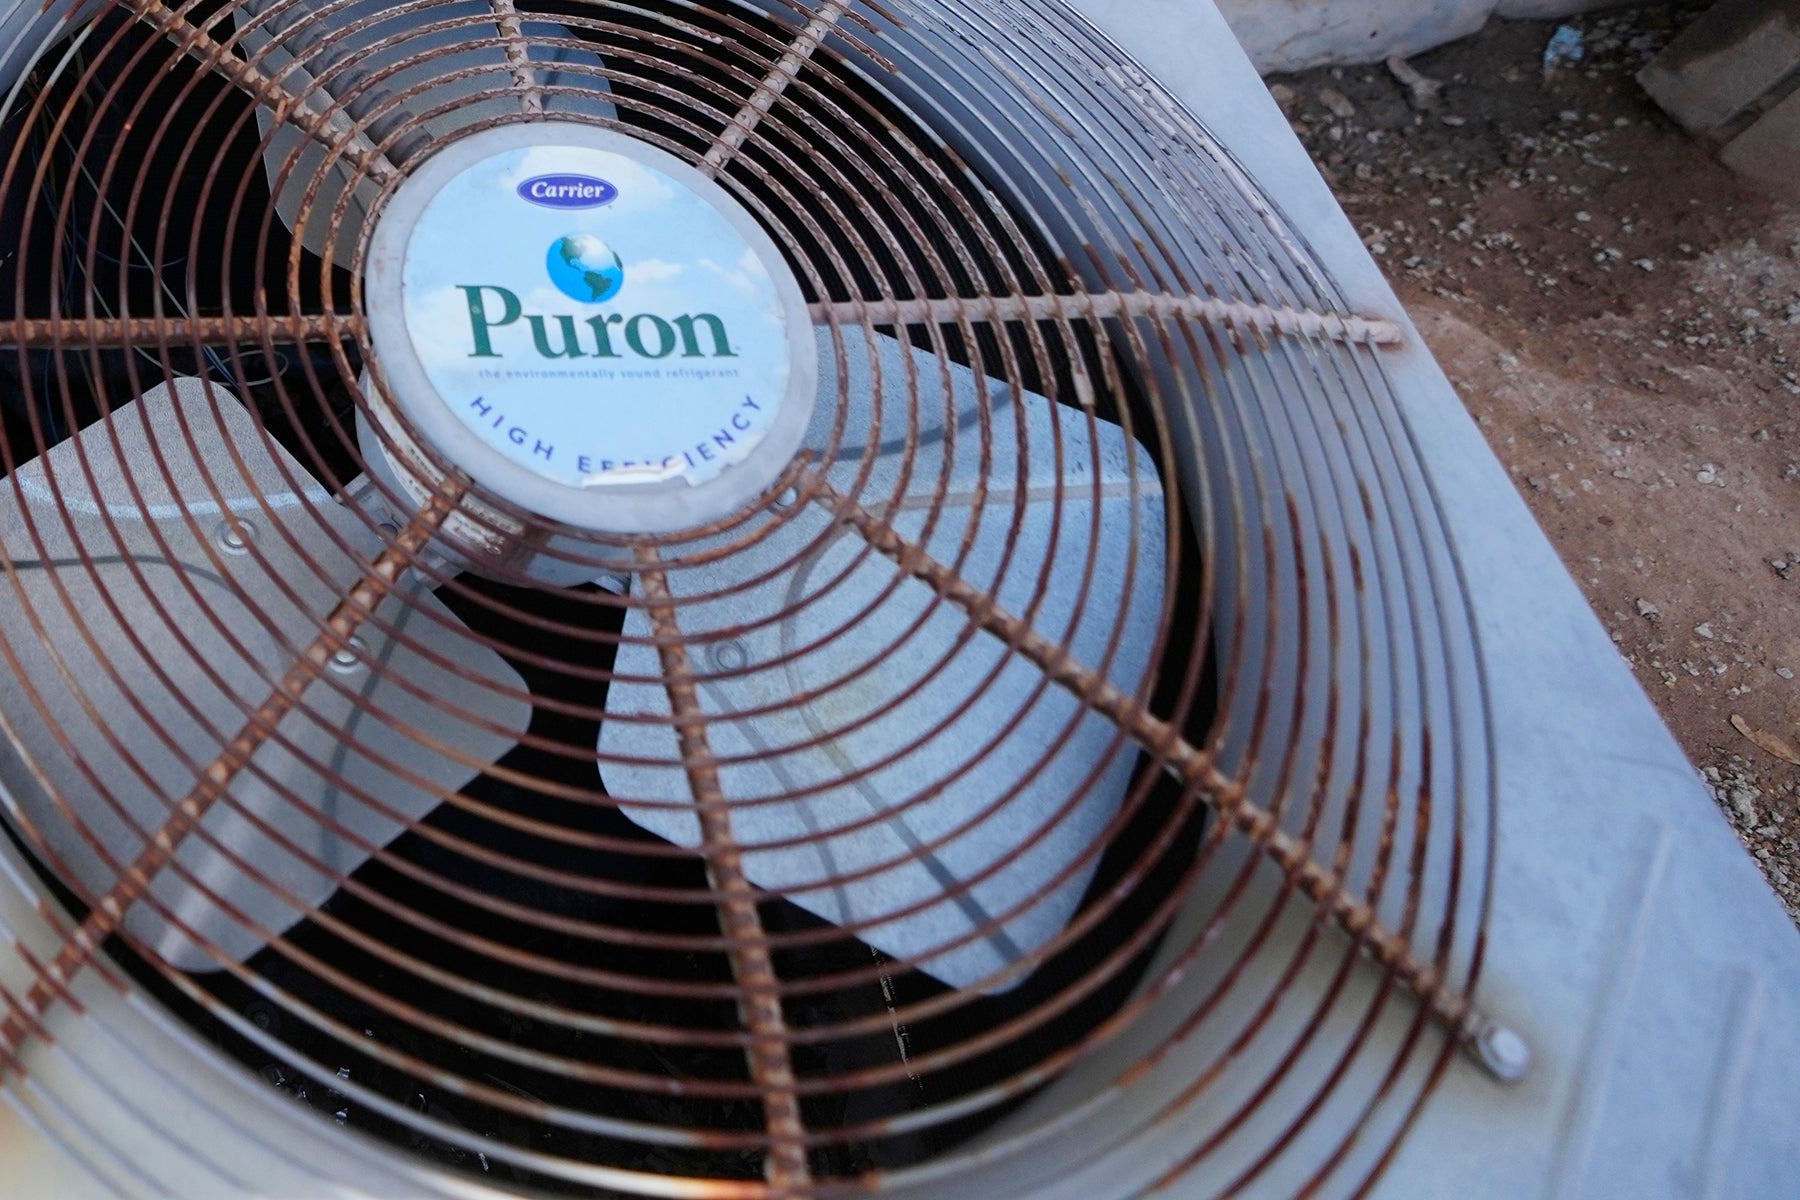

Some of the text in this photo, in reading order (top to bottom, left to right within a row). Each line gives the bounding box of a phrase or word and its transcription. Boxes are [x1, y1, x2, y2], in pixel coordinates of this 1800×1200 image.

[531, 180, 605, 199] Carrier
[455, 285, 739, 360] Puron
[478, 368, 740, 380] the environmentally sound refrigerant
[470, 395, 763, 474] HIGH EFCIENCY
